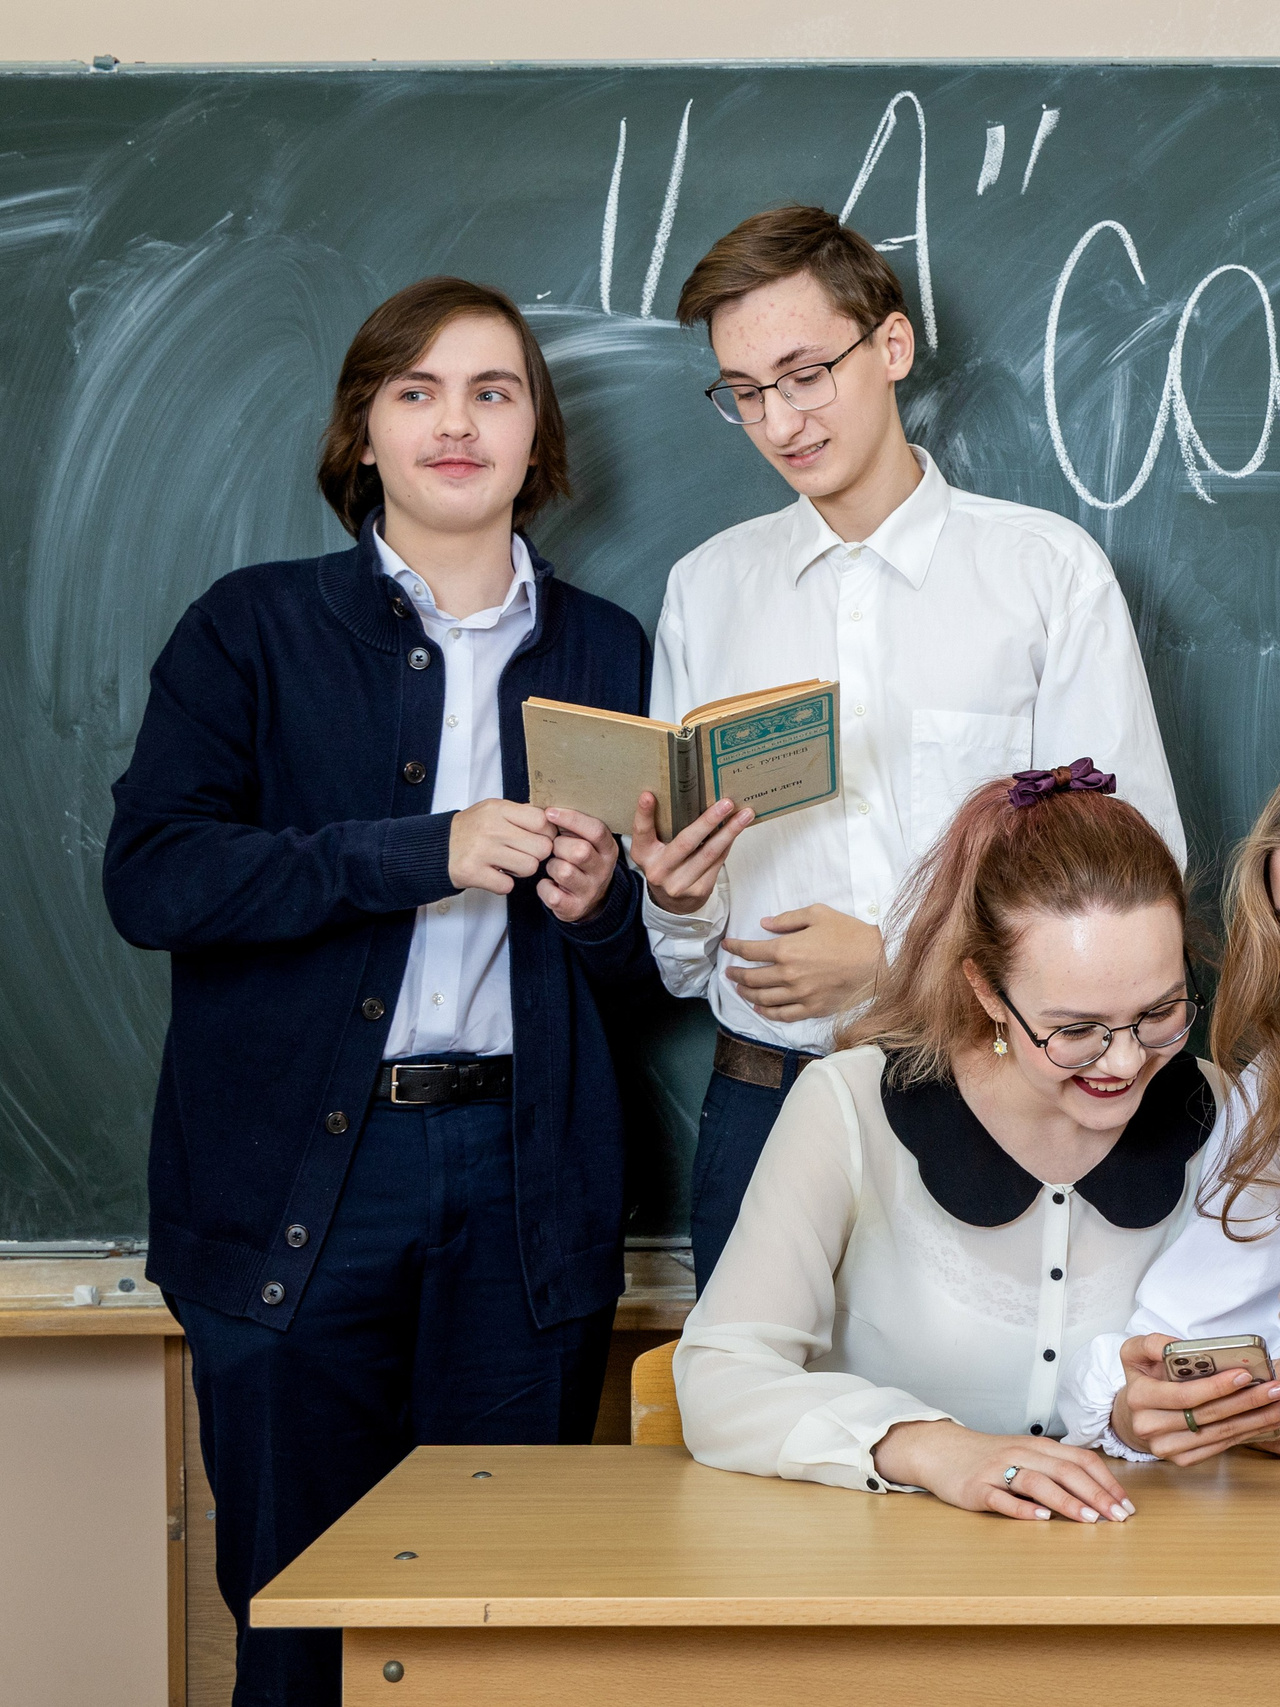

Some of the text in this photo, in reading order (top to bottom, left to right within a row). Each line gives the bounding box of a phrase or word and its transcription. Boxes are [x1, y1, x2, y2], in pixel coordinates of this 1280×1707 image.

[759, 746, 809, 765] ТУРГЕНЕВ
[743, 790, 768, 802] ОТЦЫ
[779, 780, 803, 791] ДЕТИ
